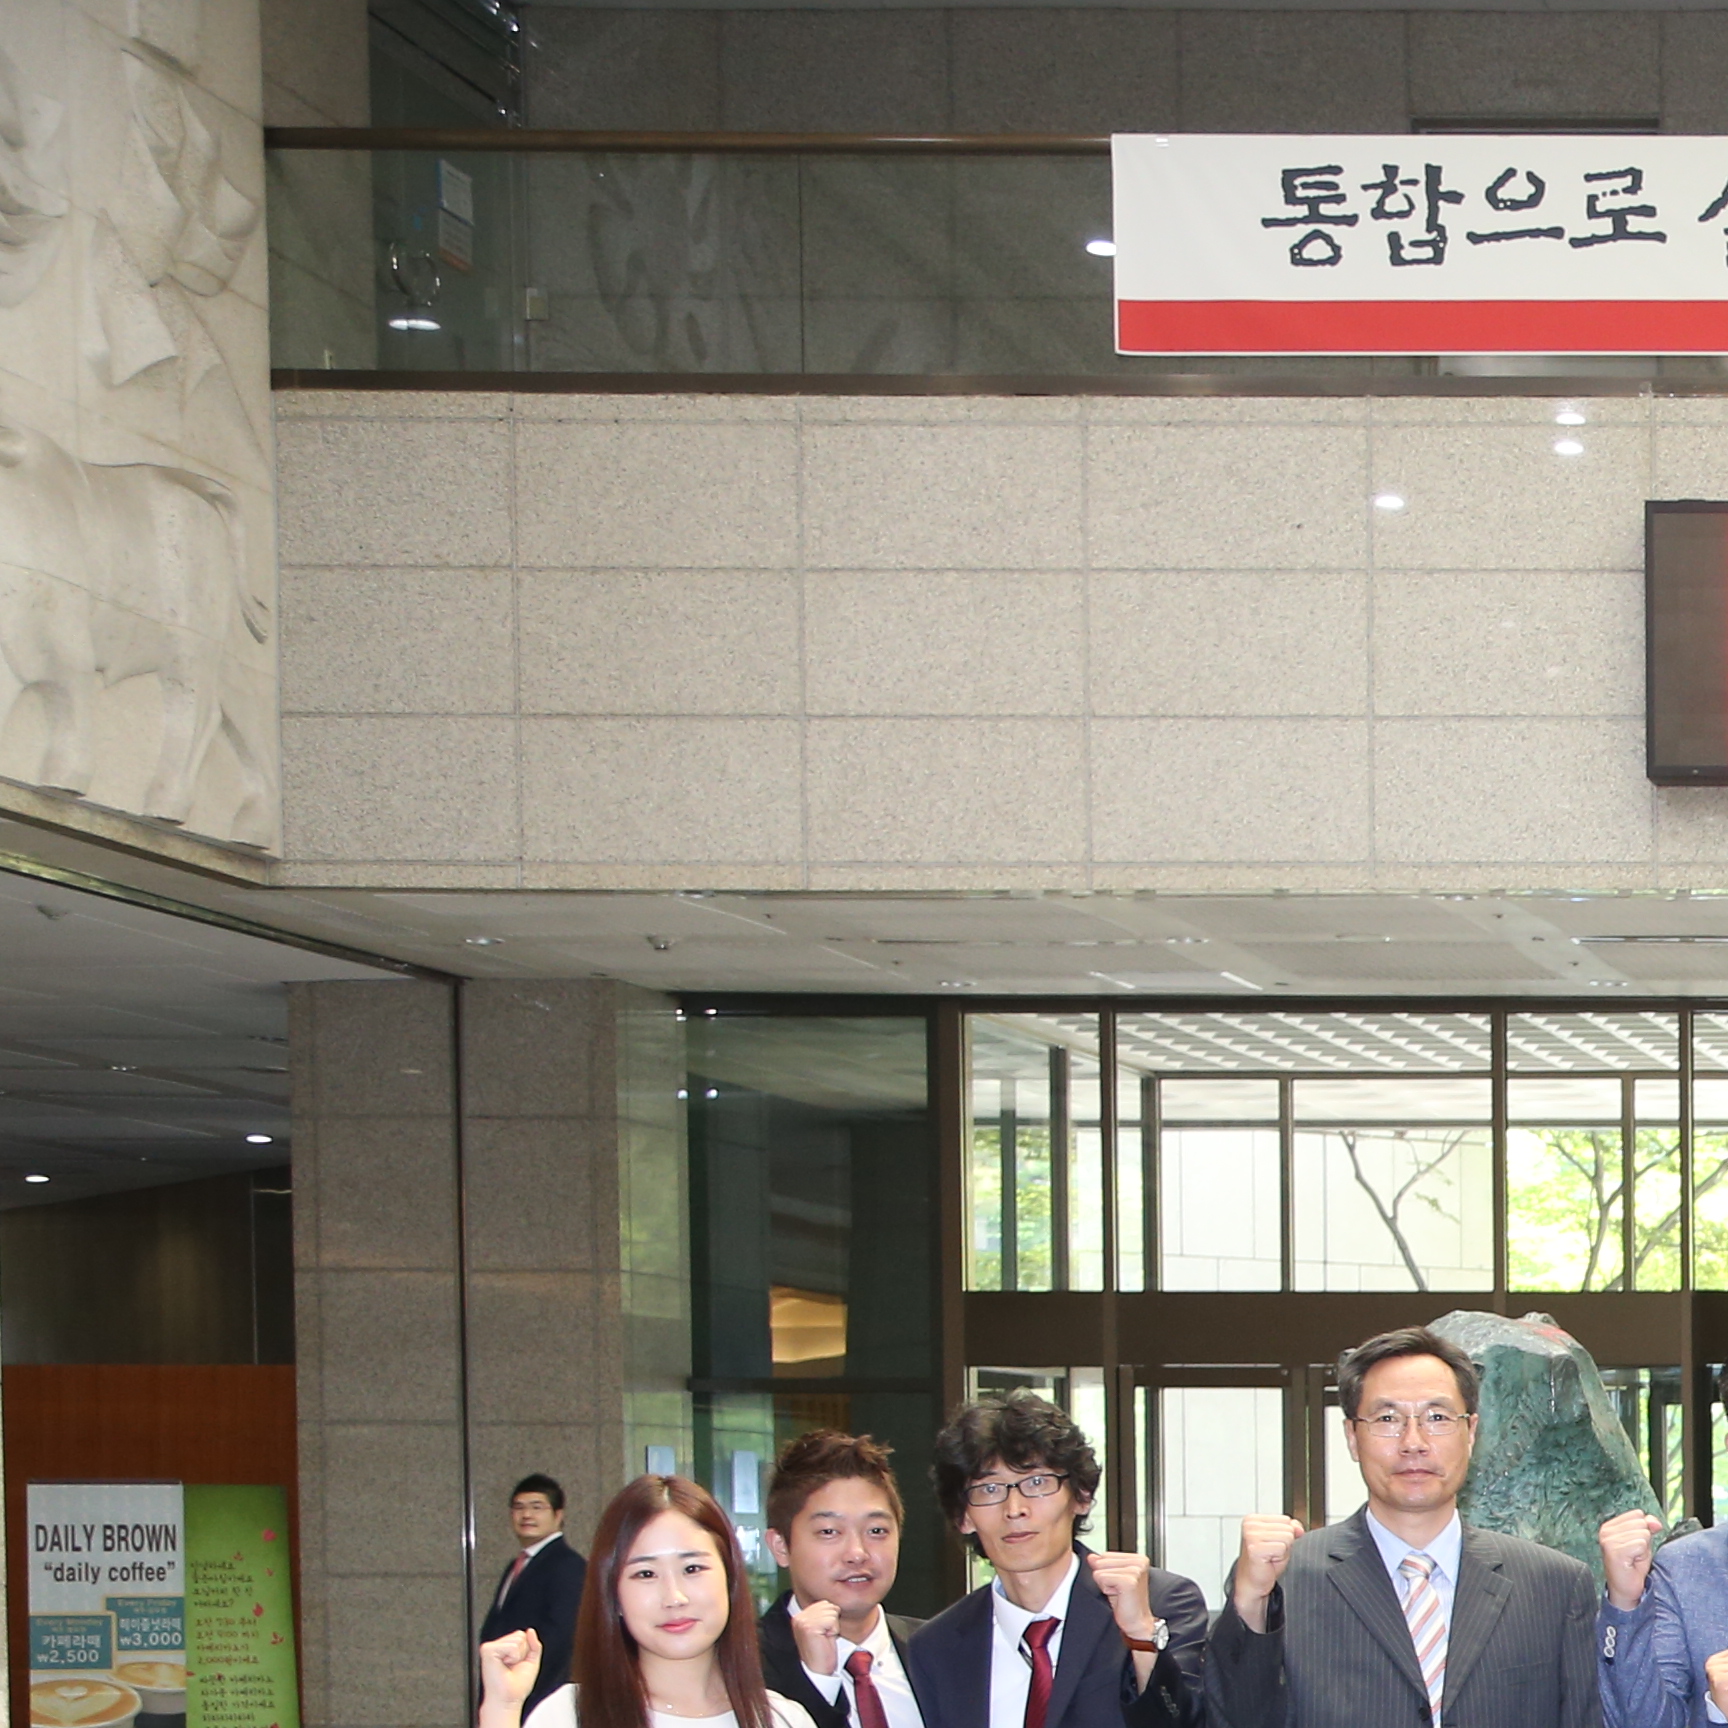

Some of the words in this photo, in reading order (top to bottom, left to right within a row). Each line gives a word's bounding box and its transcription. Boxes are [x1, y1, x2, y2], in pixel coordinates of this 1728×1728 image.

[1261, 164, 1667, 267] 통합으로
[35, 1524, 95, 1552] DAILY
[102, 1523, 177, 1552] BROWN
[41, 1634, 101, 1648] 카페라떼
